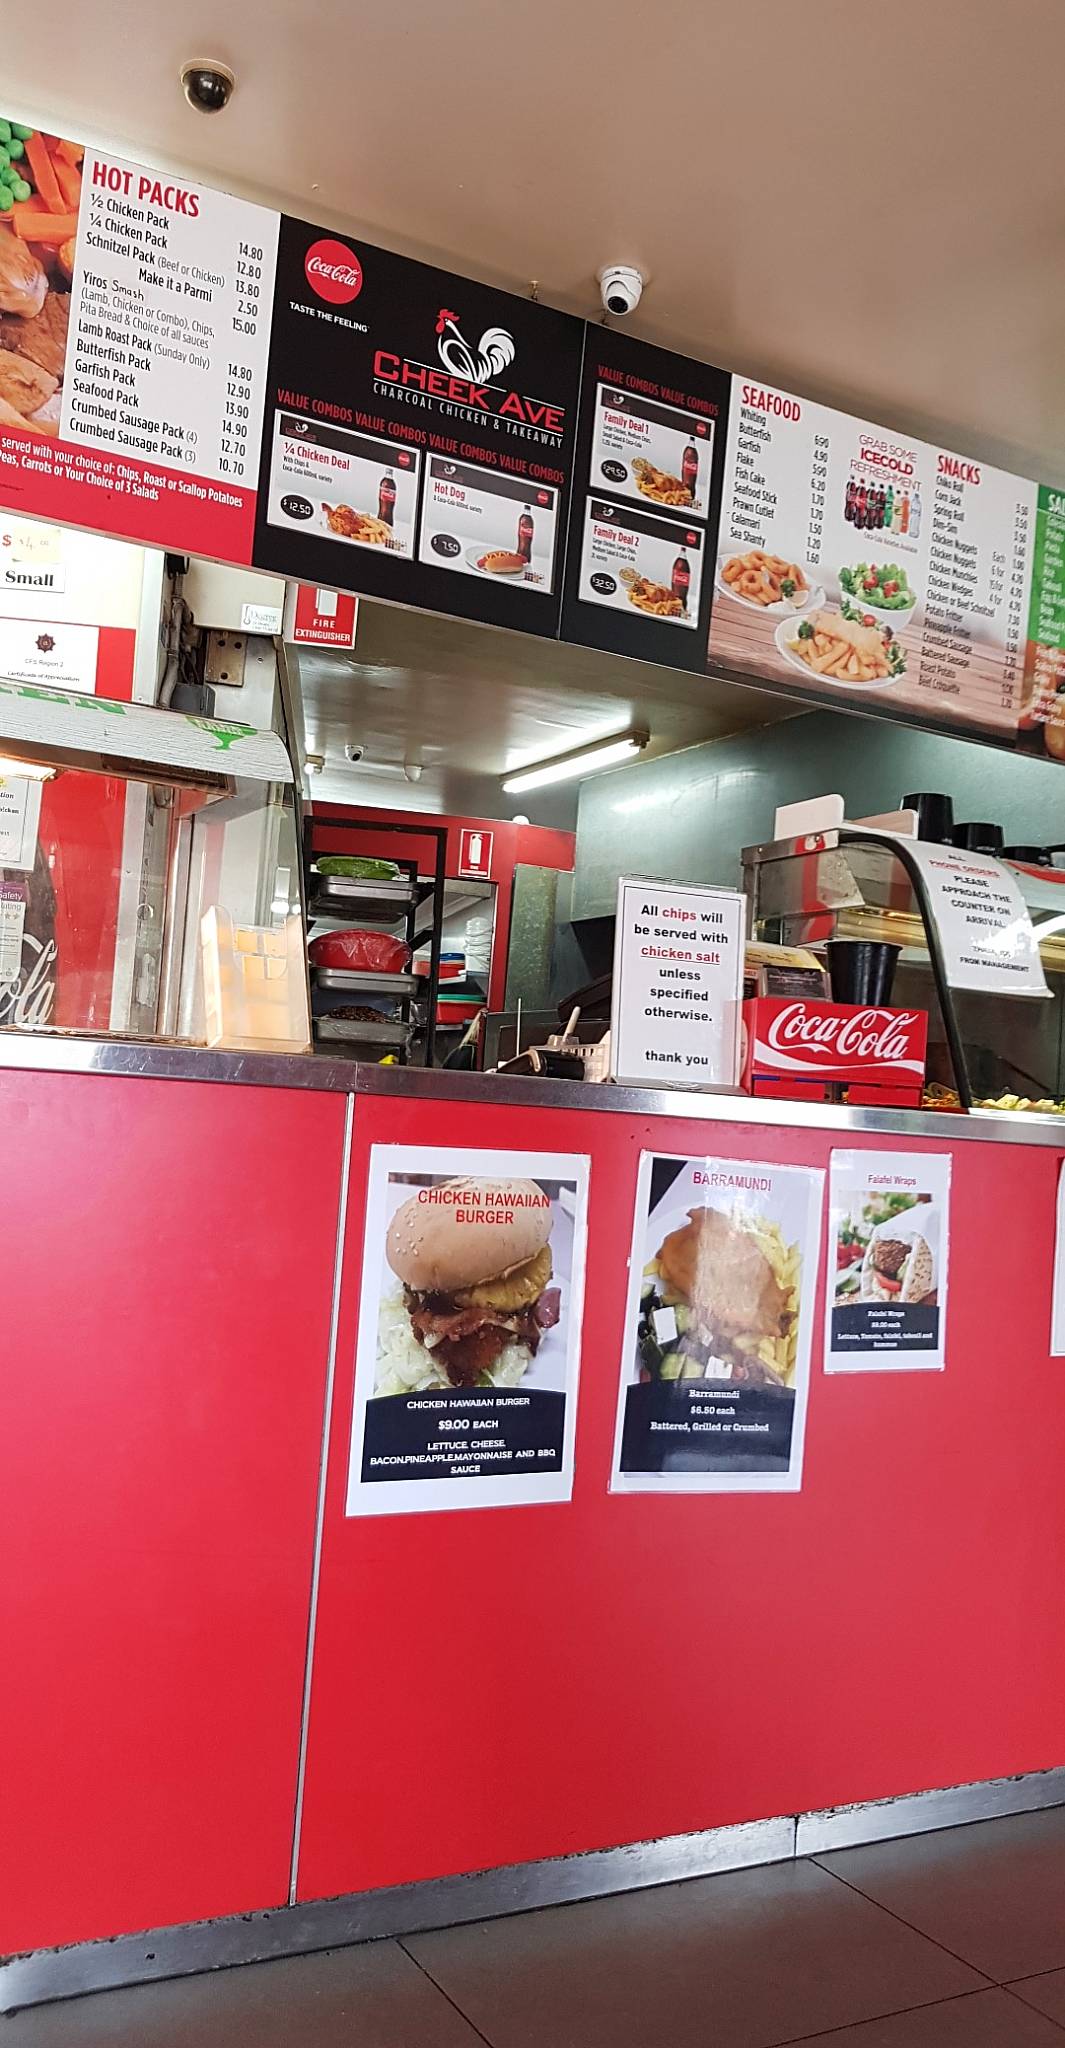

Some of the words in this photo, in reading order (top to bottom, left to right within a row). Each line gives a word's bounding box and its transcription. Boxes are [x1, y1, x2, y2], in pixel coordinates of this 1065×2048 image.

[93, 161, 133, 196] HOT
[138, 177, 199, 217] PACKS
[107, 198, 144, 222] Chicken
[147, 209, 169, 230] Pack
[105, 217, 142, 241] Chicken
[145, 228, 167, 249] Pack
[86, 232, 130, 257] Schnitzel
[133, 245, 155, 265] Pack
[239, 242, 262, 261] 14.80
[237, 261, 261, 279] 12.80
[308, 256, 360, 287] Coca-Cola
[83, 270, 107, 290] Yiros
[139, 268, 164, 287] Make
[184, 282, 212, 302] Parmi
[236, 280, 259, 298] 13.80
[111, 280, 144, 301] Smash
[81, 289, 110, 306] (Lamb,
[112, 296, 143, 315] Chicken
[192, 320, 214, 338] Chips,
[238, 300, 258, 316] 2.50
[290, 302, 315, 317] TASTE
[317, 310, 332, 322] THE
[334, 315, 367, 333] FEELING
[232, 317, 256, 335] 15.00
[79, 319, 103, 339] Lamb
[105, 327, 129, 346] Roast
[132, 333, 152, 353] Pack
[154, 343, 186, 365] (Sunday
[189, 353, 209, 370] Only)
[77, 339, 125, 366] Butterfish
[128, 352, 151, 372] Pack
[75, 359, 110, 382] Garfish
[113, 370, 136, 387] Pack
[228, 364, 252, 381] 14.80
[73, 378, 114, 401] Seafood
[116, 390, 139, 408] Pack
[227, 383, 250, 400] 12.90
[374, 351, 490, 410] CHEEK
[500, 392, 565, 432] AVE
[226, 402, 249, 419] 13.90
[742, 385, 801, 422] SEAFOOD
[72, 398, 116, 423] Crumbed
[119, 411, 160, 433] Sausage
[162, 422, 184, 440] Pack
[374, 382, 433, 410] CHARCOAL
[440, 401, 487, 427] CHICKEN
[493, 419, 499, 430] &
[506, 422, 563, 449] TAKEAWAY
[604, 411, 627, 427] Family
[629, 419, 644, 433] Deal
[741, 407, 766, 426] Whiting
[222, 420, 247, 438] 14.90
[277, 388, 309, 410] VALUE
[312, 399, 352, 423] COMBOS
[356, 411, 385, 432] VALUE
[388, 421, 426, 444] COMBOS
[429, 433, 457, 453] VALUE
[460, 443, 497, 465] COMBOS
[500, 454, 526, 473] VALUE
[529, 463, 564, 483] COMBOS
[739, 422, 772, 442] Butterfish
[70, 418, 115, 442] Crumbed
[118, 431, 158, 453] Sausage
[160, 441, 182, 460] Pack
[221, 439, 245, 456] 12.70
[738, 438, 761, 454] Garfish
[859, 434, 888, 452] GRAB
[889, 445, 918, 463] SOME
[219, 458, 243, 475] 10.70
[297, 446, 329, 465] Chicken
[332, 455, 350, 470] Deal
[736, 452, 754, 467] Flake
[860, 448, 914, 475] ICECOLD
[2, 437, 31, 455] served
[33, 444, 52, 459] with
[117, 465, 141, 482] Chips,
[143, 472, 166, 489] Roast
[179, 481, 206, 500] Scallop
[208, 490, 242, 508] Potatoes
[21, 457, 51, 473] Carrots
[65, 467, 84, 482] Your
[132, 483, 159, 501] Salads
[736, 467, 748, 480] Fish
[750, 471, 765, 485] Cake
[850, 459, 922, 491] REFRESHMENT
[938, 455, 980, 485] SNACKS
[434, 482, 448, 495] Hot
[450, 486, 465, 500] Dog
[734, 482, 761, 500] Seafood
[762, 490, 777, 504] Stick
[733, 497, 754, 513] Prawn
[755, 503, 774, 519] Cutlet
[731, 512, 760, 529] Calamari
[594, 525, 617, 541] Family
[618, 531, 633, 545] Deal
[730, 527, 742, 539] Sea
[743, 531, 765, 548] Shanty
[5, 570, 54, 587] Small
[313, 619, 335, 628] FIRE
[296, 629, 350, 642] EXTINGUISHER
[954, 876, 989, 887] PLEASE
[941, 885, 992, 900] APPROACH
[992, 894, 1012, 903] THE
[641, 905, 658, 916] All
[662, 907, 697, 922] chips
[701, 913, 723, 923] will
[951, 899, 995, 913] COUNTER
[635, 924, 650, 935] be
[654, 928, 696, 940] served
[701, 932, 728, 943] with
[641, 946, 691, 960] chicken
[696, 952, 720, 963] salt
[659, 969, 701, 980] unless
[650, 987, 709, 1001] specified
[645, 1007, 712, 1022] otherwise.
[768, 1003, 919, 1059] Coca-Cola
[646, 1050, 681, 1063] thank
[686, 1055, 708, 1066] you
[693, 1172, 772, 1192] BARRAMUNDI
[894, 1176, 916, 1186] Wraps
[418, 1190, 481, 1206] CHICKEN
[485, 1193, 550, 1208] HAWAIIAN
[456, 1209, 513, 1224] BURGER
[407, 1400, 447, 1409] CHICKEN
[450, 1399, 494, 1408] HAWAIIAN
[496, 1397, 530, 1406] BURGER
[688, 1389, 740, 1399] Barramundi
[716, 1406, 735, 1415] each
[438, 1419, 470, 1431] $9.00
[473, 1420, 499, 1429] EACH
[650, 1422, 691, 1433] Battered,
[692, 1422, 721, 1432] Grilled
[732, 1422, 769, 1432] Crumbed
[515, 1450, 535, 1458] AND
[538, 1449, 556, 1457] BBQ
[451, 1465, 480, 1474] SAUCE
